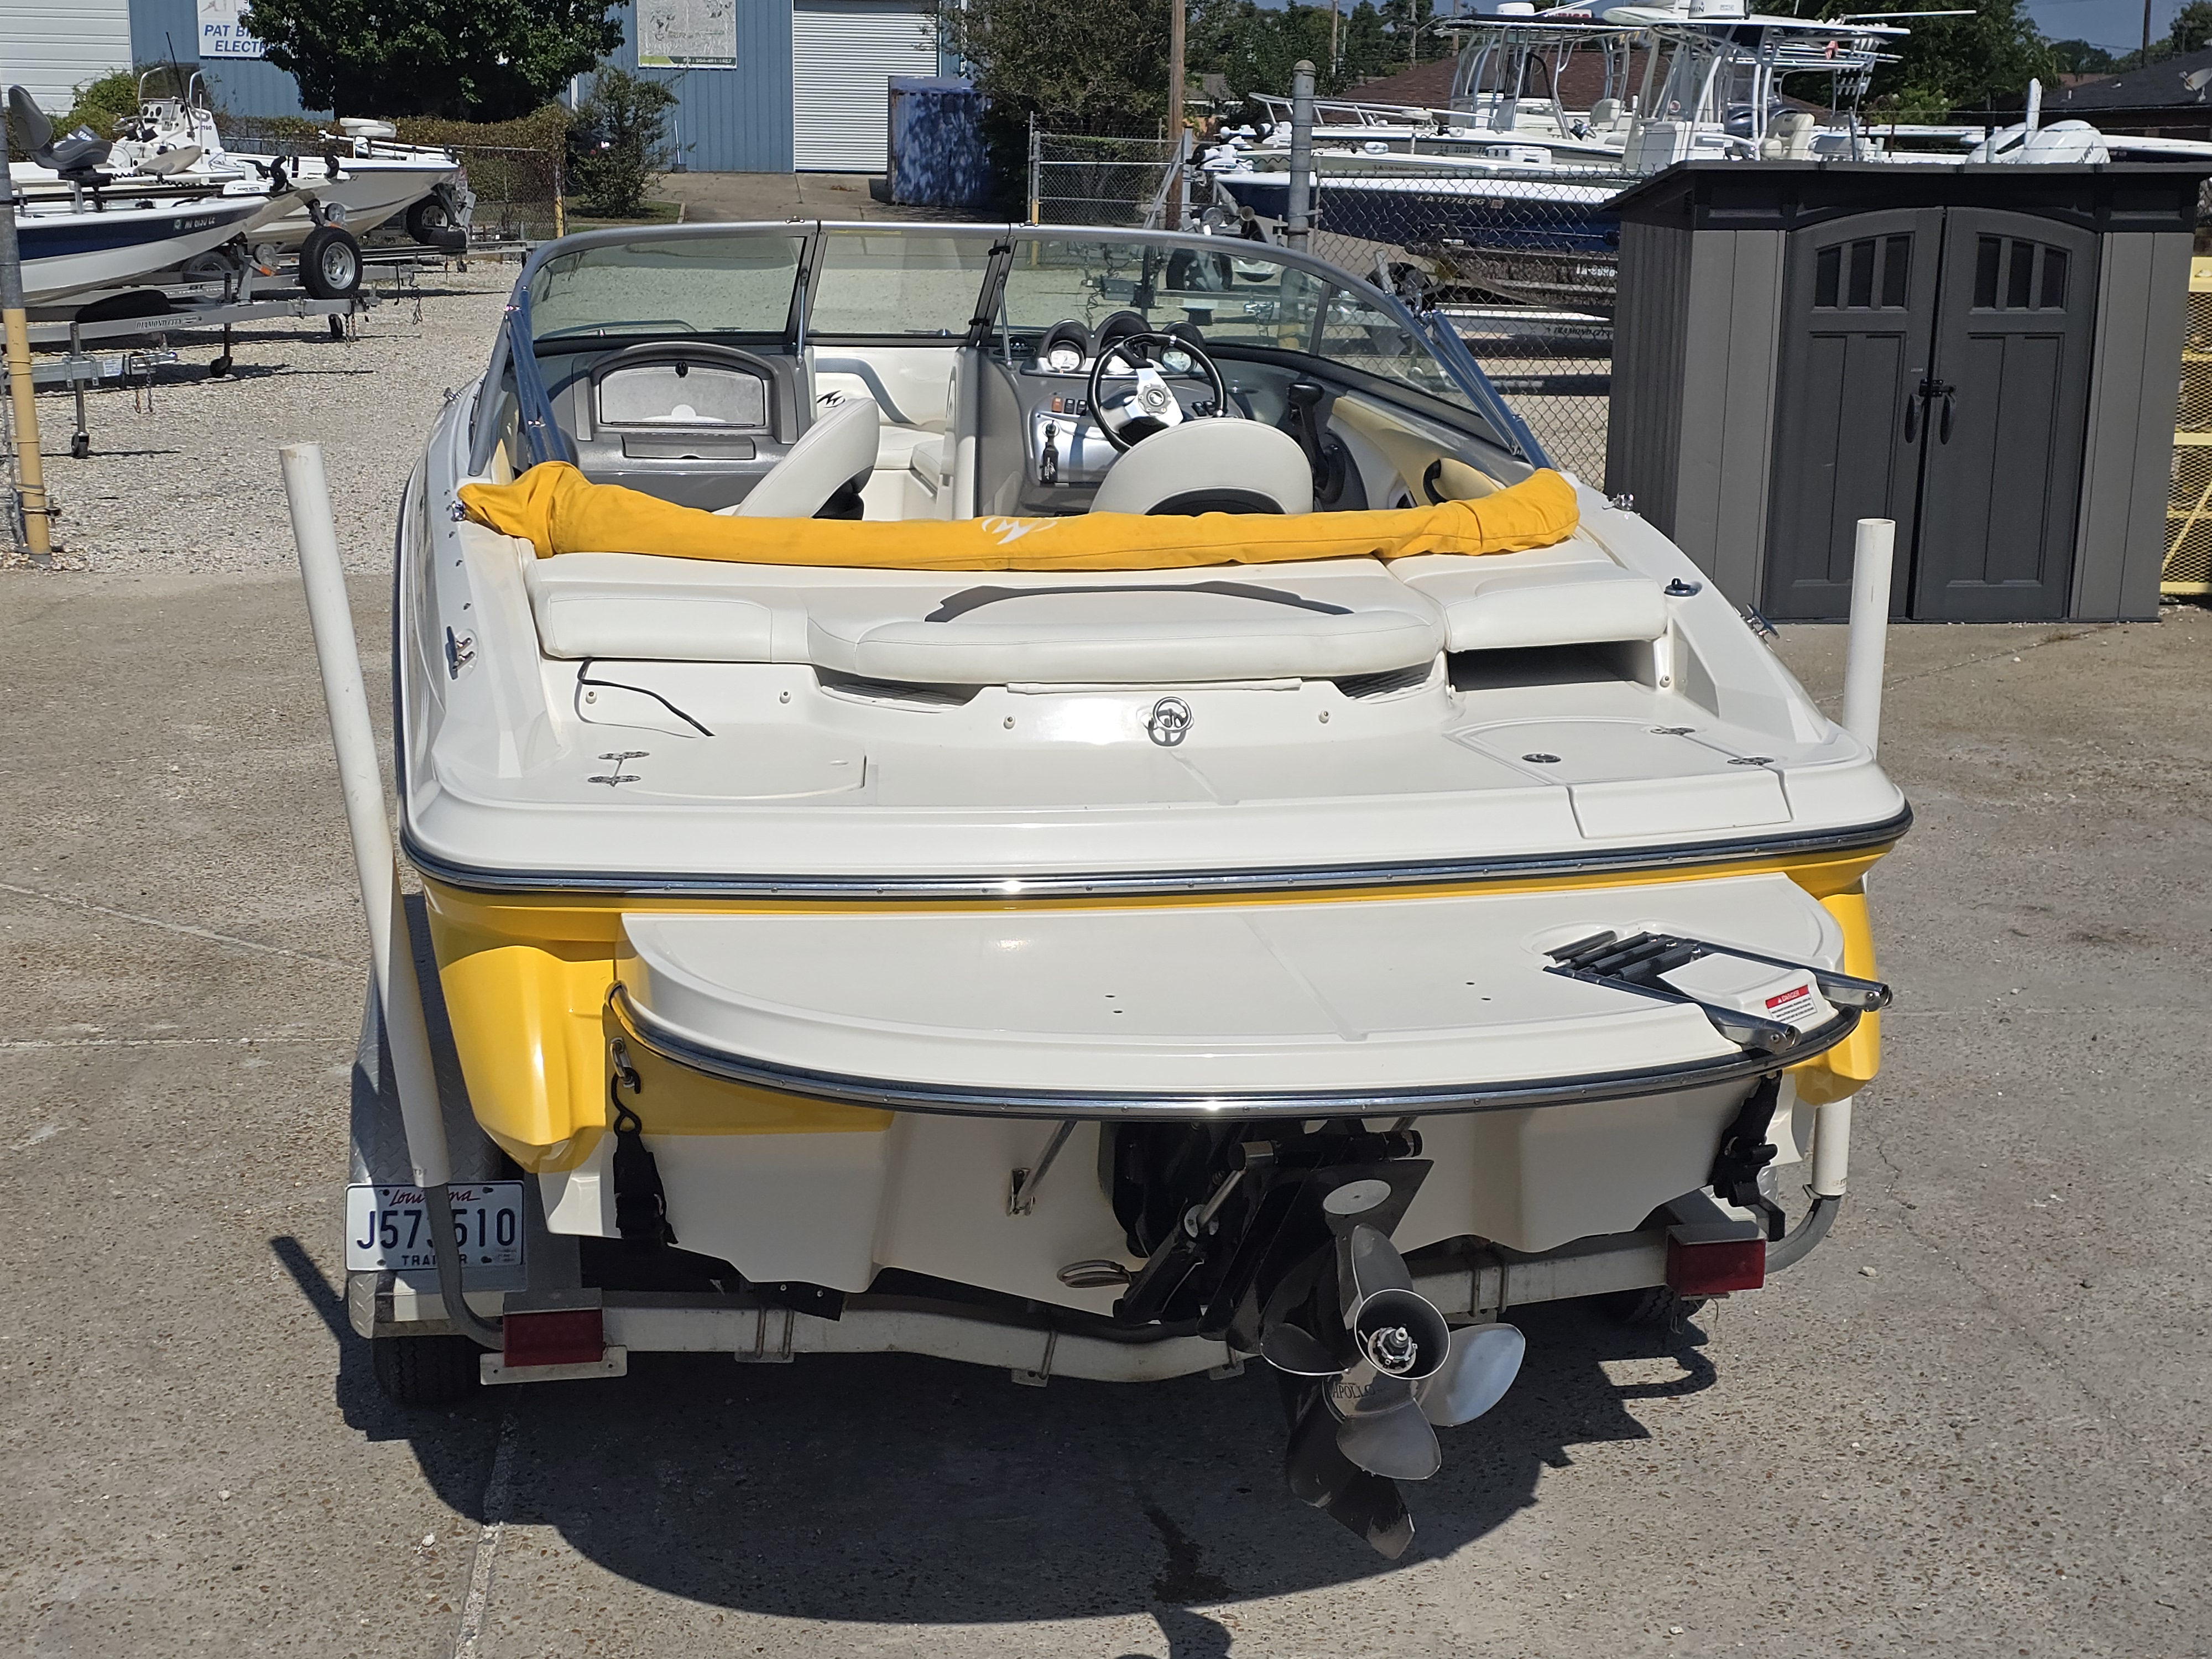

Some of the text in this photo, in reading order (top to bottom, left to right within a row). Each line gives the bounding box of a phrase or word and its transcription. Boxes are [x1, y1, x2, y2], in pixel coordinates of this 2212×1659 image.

[204, 24, 231, 36] PAT
[137, 320, 166, 329] DIAMOND
[389, 1190, 481, 1207] Louina
[357, 1208, 515, 1249] J57510
[401, 1254, 467, 1266] TRAIR
[1333, 1384, 1375, 1399] APOLLO
